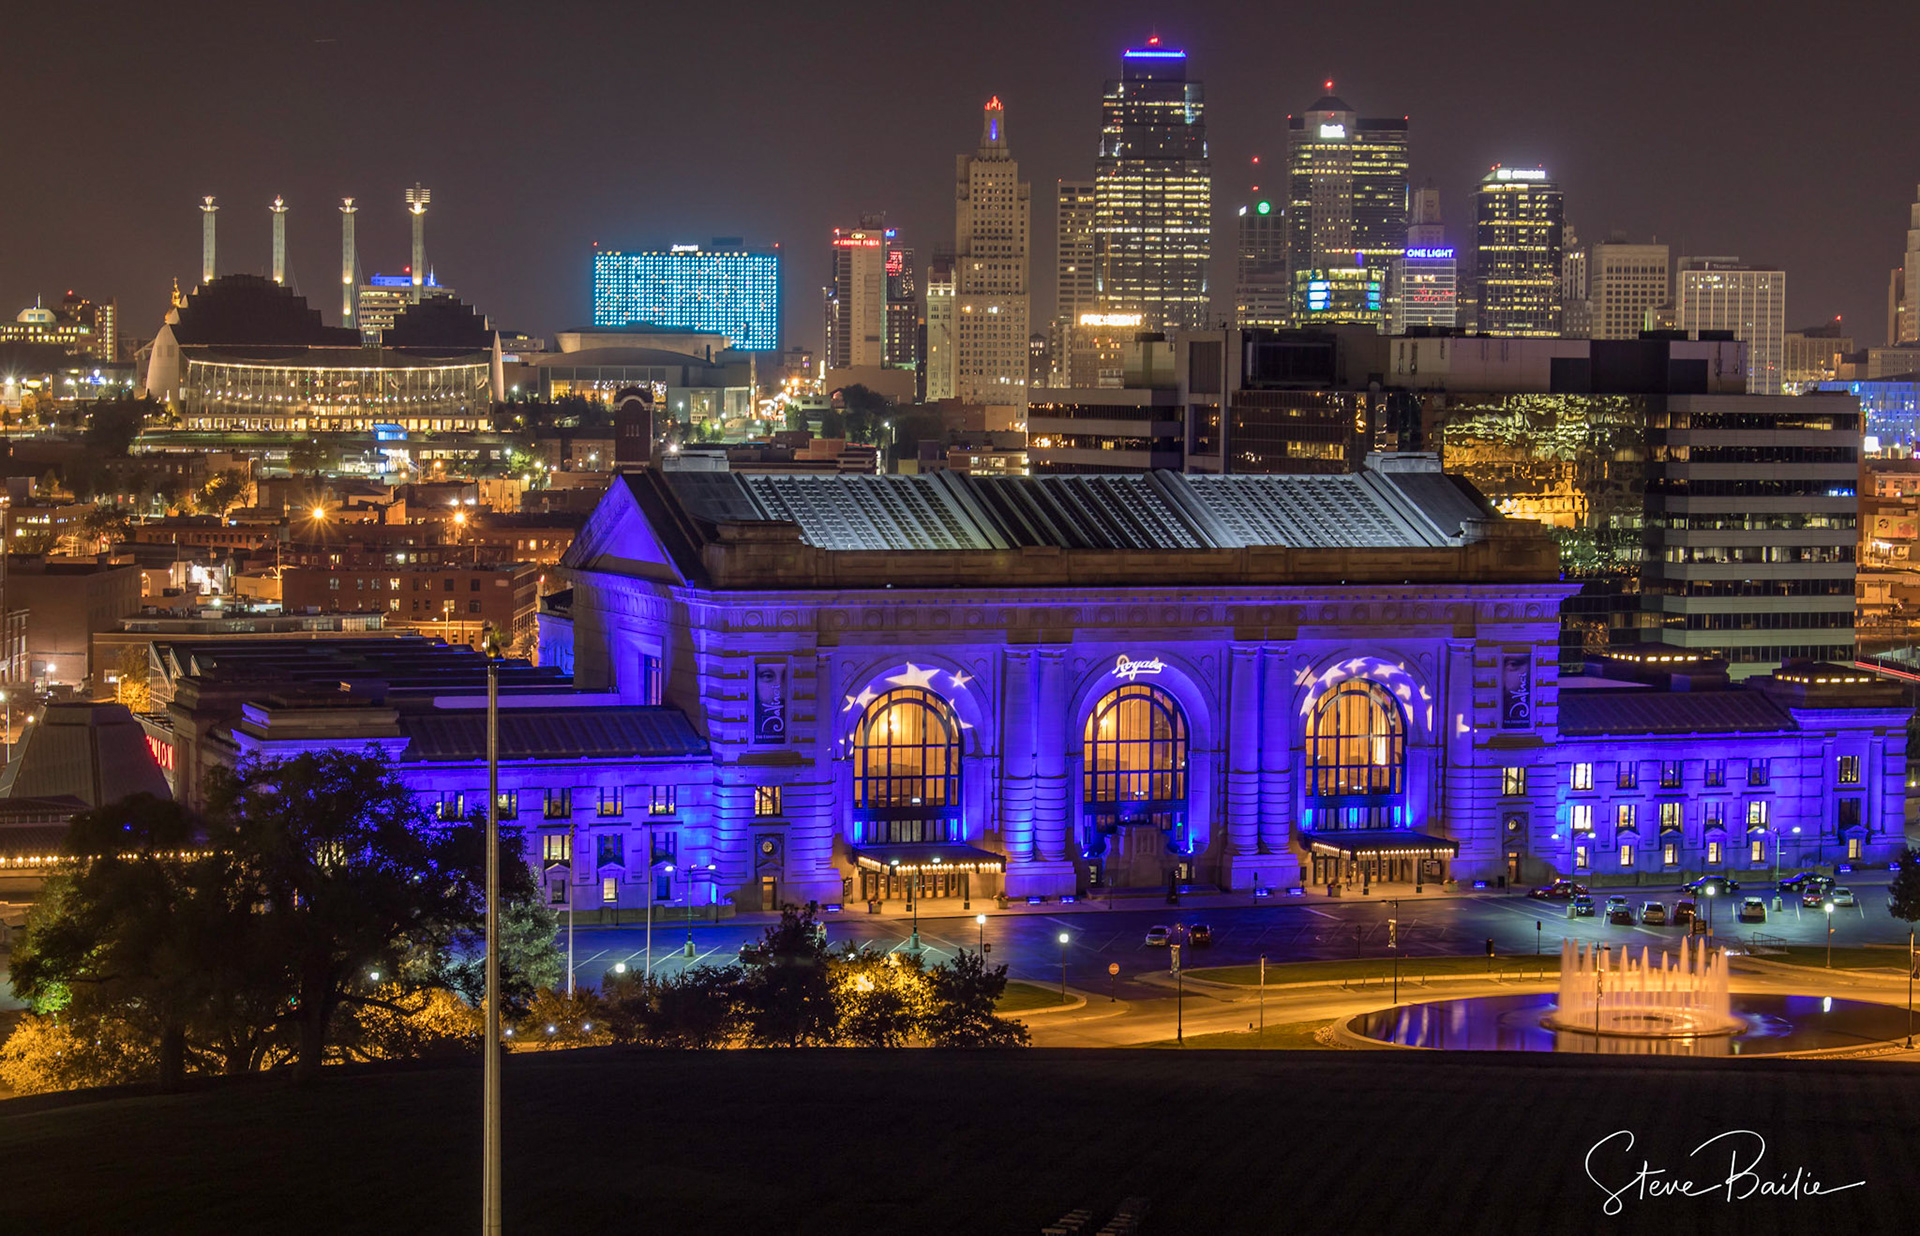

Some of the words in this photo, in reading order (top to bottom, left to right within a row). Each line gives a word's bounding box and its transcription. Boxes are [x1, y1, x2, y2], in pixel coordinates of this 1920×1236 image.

[1406, 249, 1426, 258] ONE
[1427, 249, 1454, 258] LIGHT
[1111, 654, 1168, 681] Royals
[146, 734, 174, 771] NION
